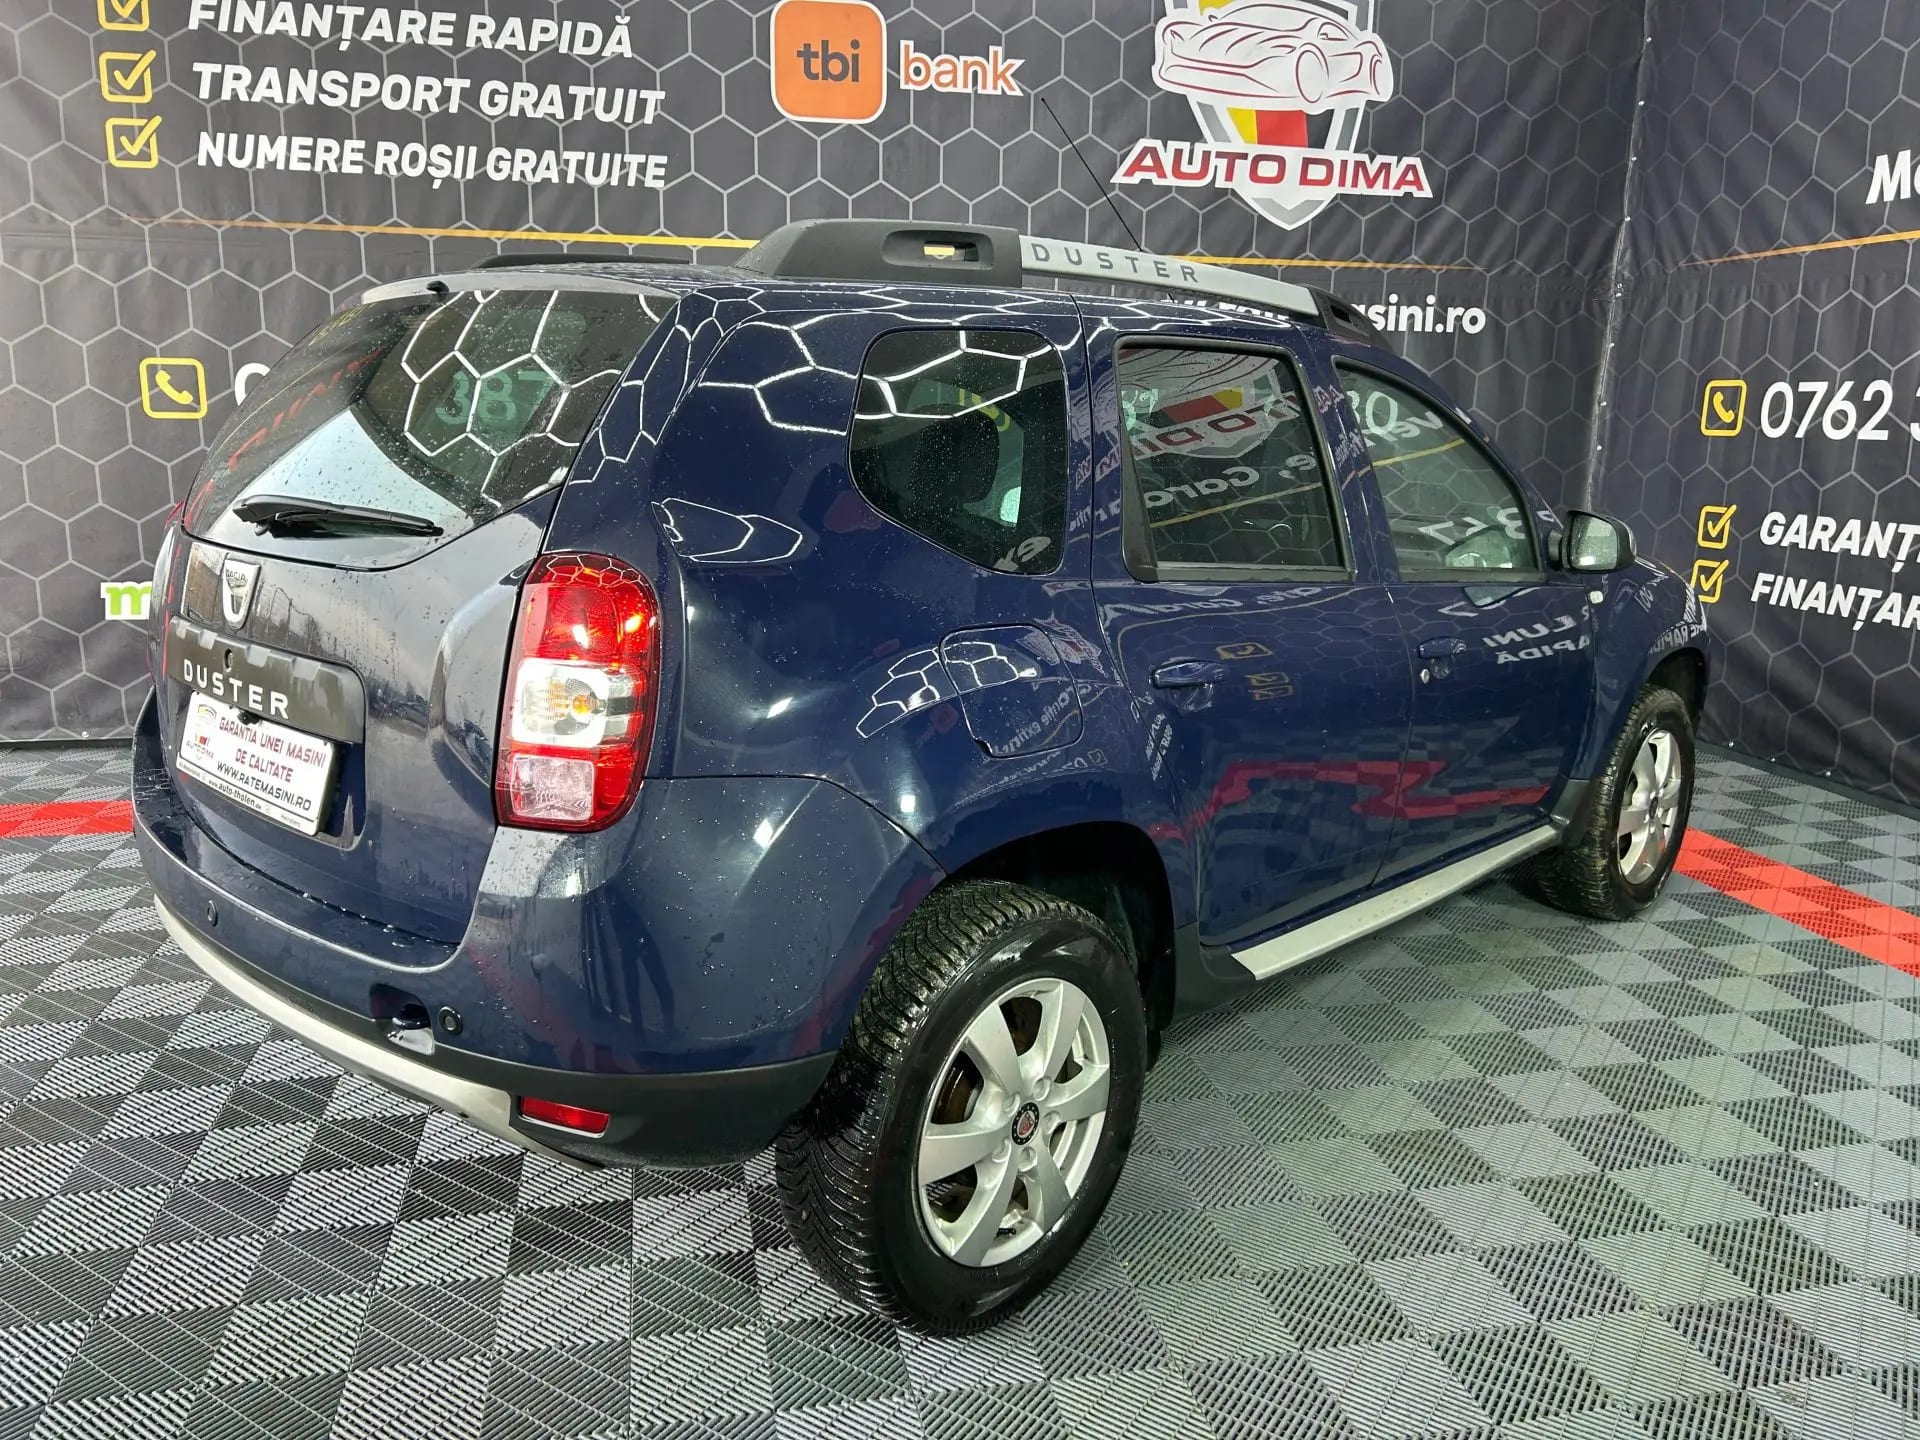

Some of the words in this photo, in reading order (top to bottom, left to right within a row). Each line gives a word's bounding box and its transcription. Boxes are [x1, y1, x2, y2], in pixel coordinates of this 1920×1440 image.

[465, 14, 633, 58] RAPIDĂ
[192, 62, 471, 114] TRANSPORT
[479, 79, 666, 125] GRATUIT
[796, 38, 860, 83] tbi
[903, 43, 1018, 94] bank
[197, 131, 366, 174] NUMERE
[374, 141, 477, 189] ROȘII
[486, 147, 668, 188] GRATUITE
[1121, 144, 1286, 185] AUTO
[1298, 157, 1426, 193] DIMA
[1865, 149, 1920, 205] M
[1031, 241, 1200, 284] DUSTER
[1760, 379, 1894, 441] 0762
[1759, 511, 1920, 573] GARANȚ
[183, 658, 289, 720] DUSTER
[219, 717, 257, 744] GARANTIA
[260, 733, 284, 754] UNEI
[286, 742, 327, 769] MASINI
[234, 748, 247, 764] DE
[248, 754, 294, 783] CALITATE
[217, 761, 312, 812] WWW.RATEMASINI.RO
